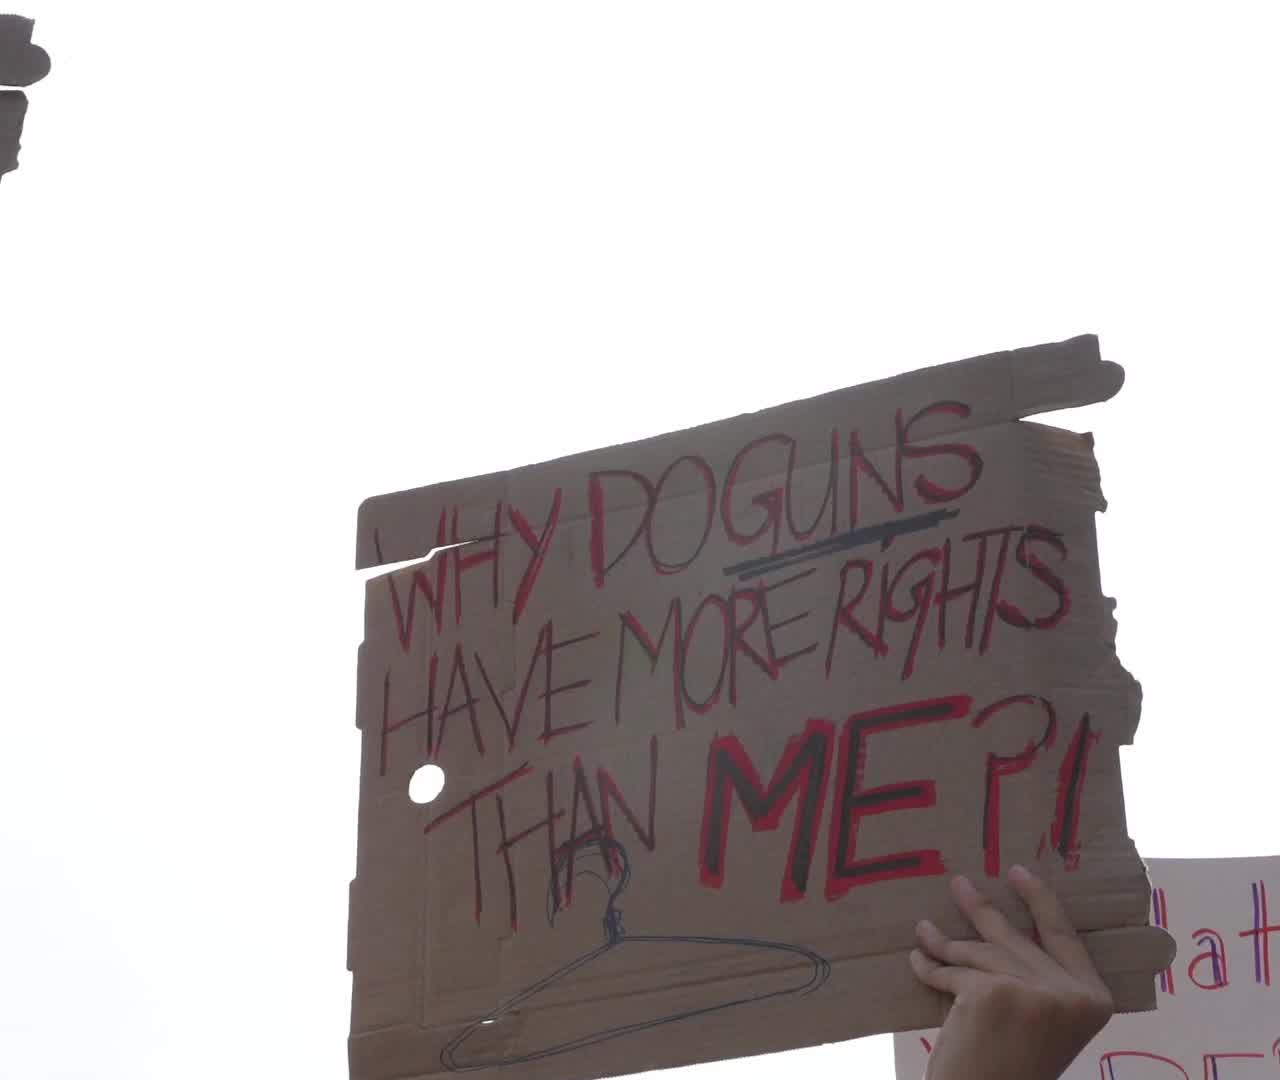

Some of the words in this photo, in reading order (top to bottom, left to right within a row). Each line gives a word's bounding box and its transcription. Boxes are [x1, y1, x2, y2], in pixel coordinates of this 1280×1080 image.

[373, 487, 563, 656] WHY
[585, 455, 718, 588] DO
[720, 400, 984, 547] GUNS
[378, 619, 600, 777] HAVE
[615, 567, 818, 731] MORE
[825, 524, 1072, 682] RIGHTS
[423, 732, 661, 932] THAN
